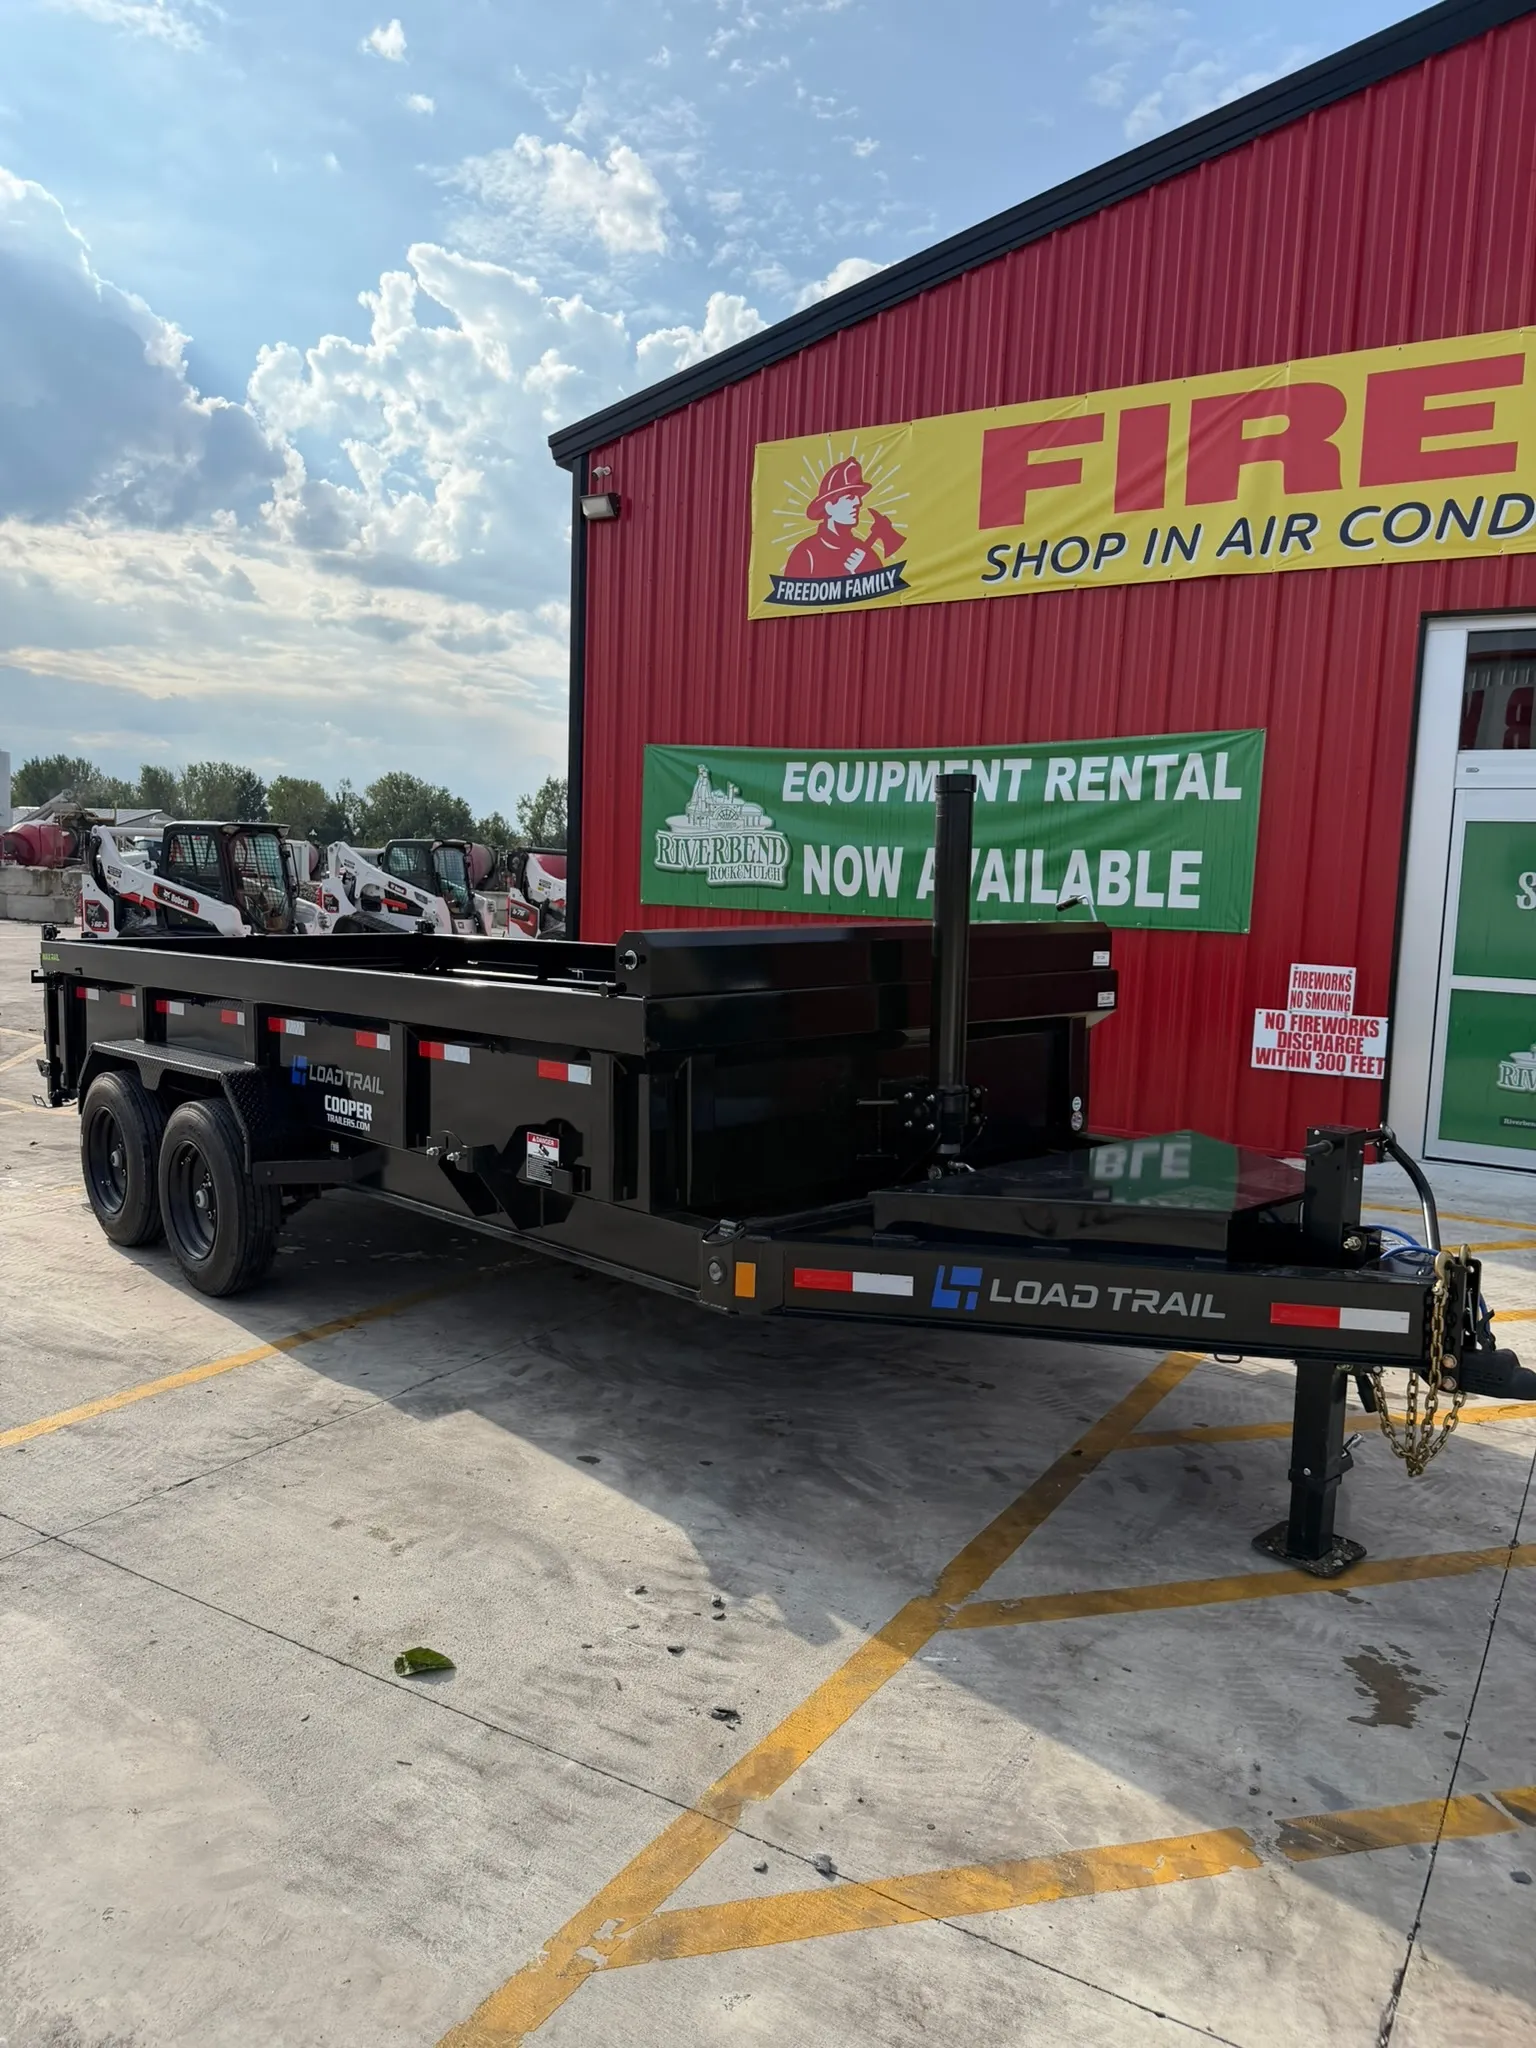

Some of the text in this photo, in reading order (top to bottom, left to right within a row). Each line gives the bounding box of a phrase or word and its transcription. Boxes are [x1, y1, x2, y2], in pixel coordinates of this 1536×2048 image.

[978, 352, 1526, 530] FIRE
[981, 493, 1536, 584] SHOP IN AIR COND
[776, 569, 896, 601] FREEDOM FAMILY
[1044, 752, 1242, 802] RENTAL
[656, 835, 786, 866] RIVERBEND
[803, 844, 1203, 909] NOW AAILABLE
[171, 893, 190, 909] Bobcat
[1293, 970, 1352, 992] FIREWORKS
[1290, 990, 1352, 1012] NO SMOKING
[1264, 1012, 1380, 1038] NO FIREWORKS
[1277, 1031, 1364, 1055] DISCHARGE
[1256, 1047, 1385, 1075] WITHIN 300 FEET
[309, 1064, 344, 1086] LOAD
[345, 1071, 385, 1095] TRAIL
[324, 1094, 373, 1121] COOPER
[326, 1113, 371, 1132] TRAILERS.COM
[989, 1278, 1099, 1309] LOAD
[1107, 1286, 1226, 1319] TRAIL
